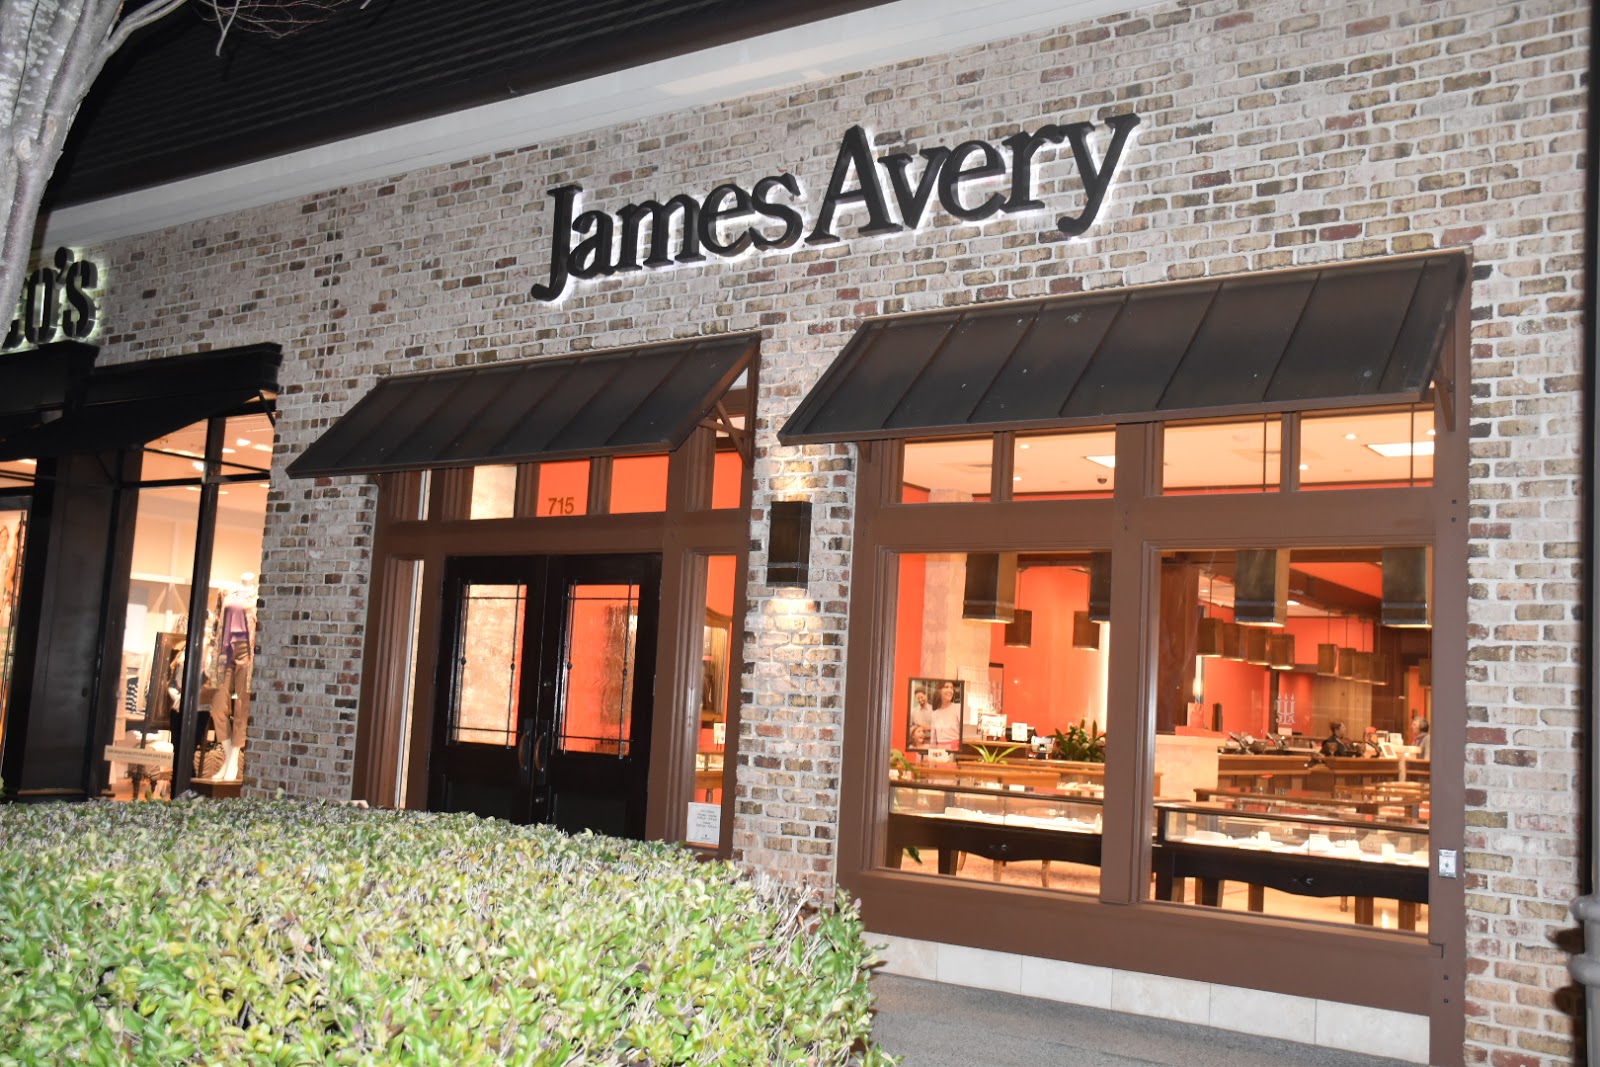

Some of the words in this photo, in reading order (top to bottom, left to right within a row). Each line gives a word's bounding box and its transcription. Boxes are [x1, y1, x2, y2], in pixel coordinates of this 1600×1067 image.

[531, 173, 803, 301] James
[804, 113, 1141, 236] Avery
[548, 496, 575, 515] 715
